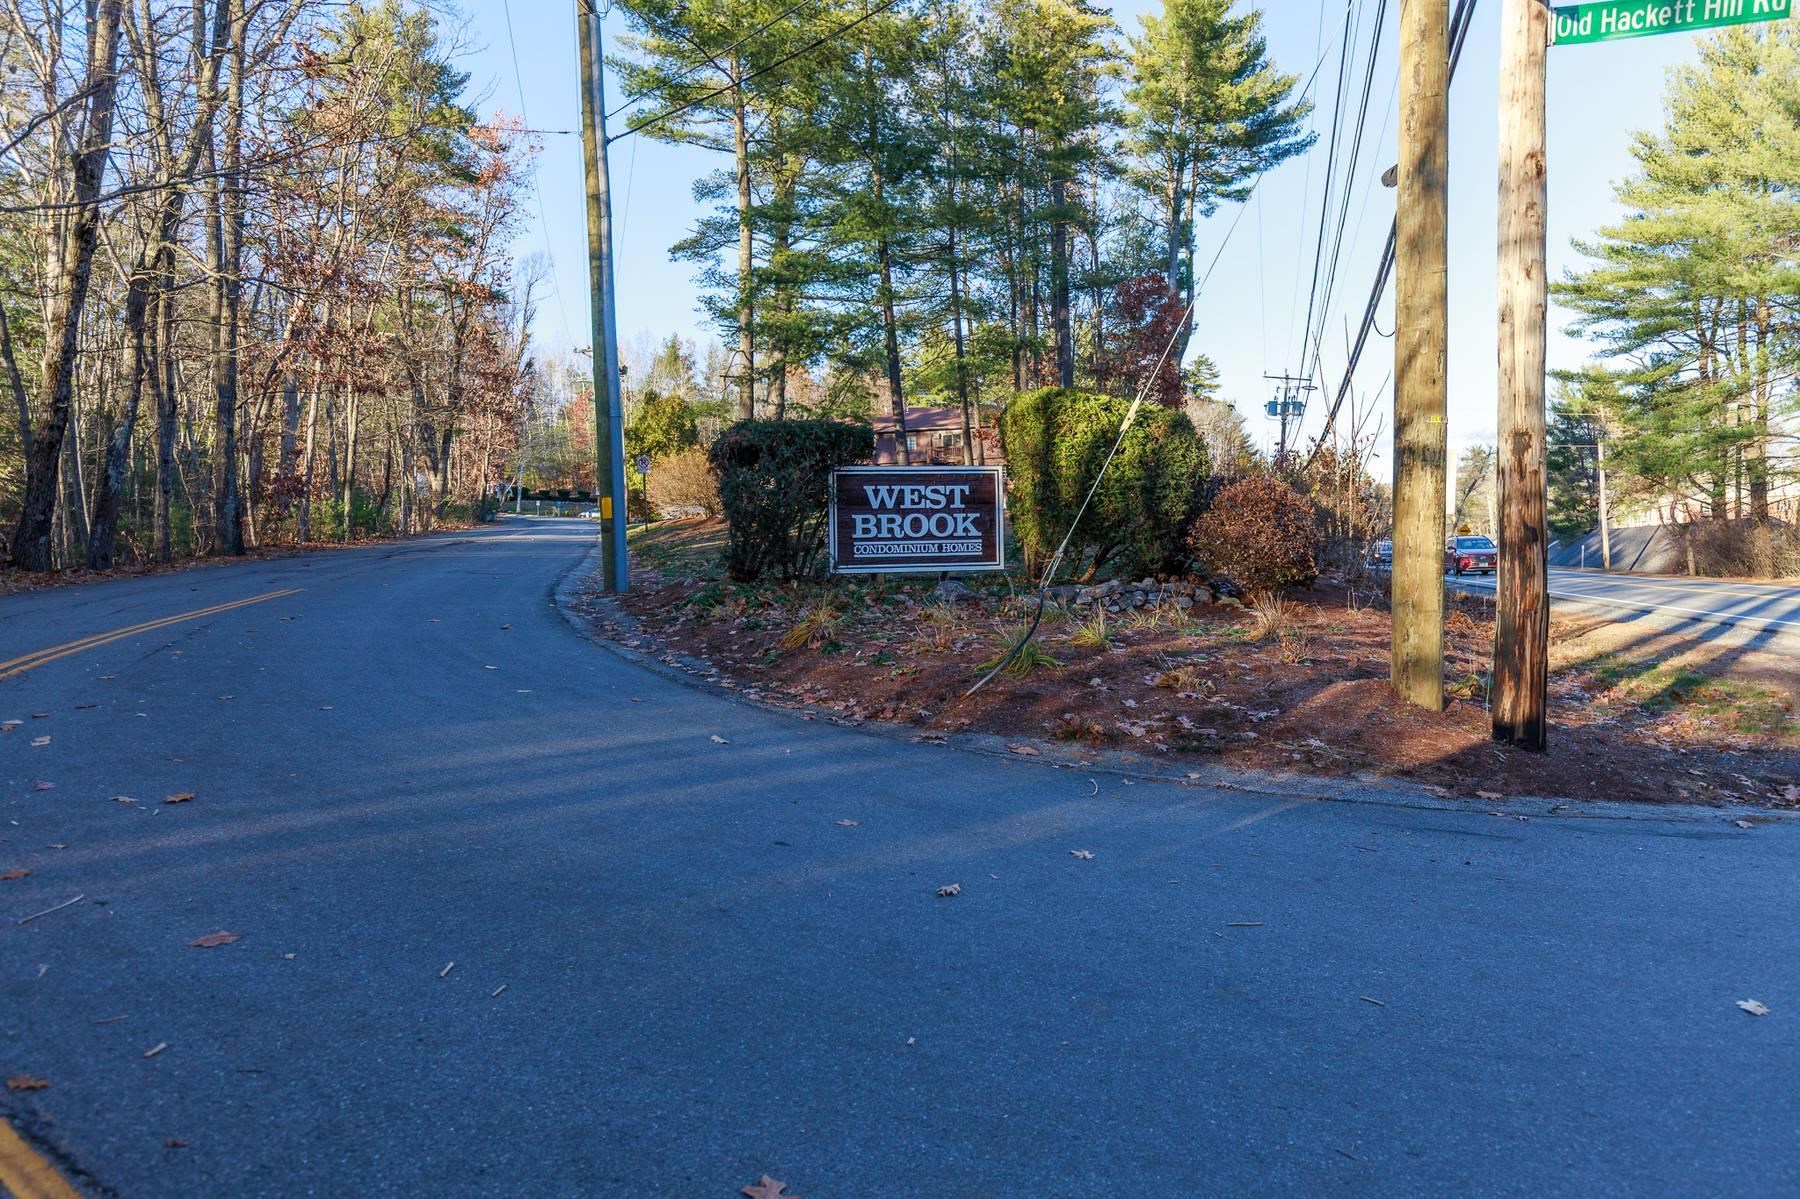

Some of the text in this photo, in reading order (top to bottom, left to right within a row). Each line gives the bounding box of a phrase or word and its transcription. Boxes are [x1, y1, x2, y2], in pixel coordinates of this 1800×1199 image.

[1557, 13, 1592, 37] Old
[1601, 2, 1695, 33] Hackett
[1704, 0, 1743, 20] Hill
[863, 485, 970, 509] WEST
[852, 513, 982, 538] BROOK
[854, 542, 982, 554] CONDOMINIUM HOMES
